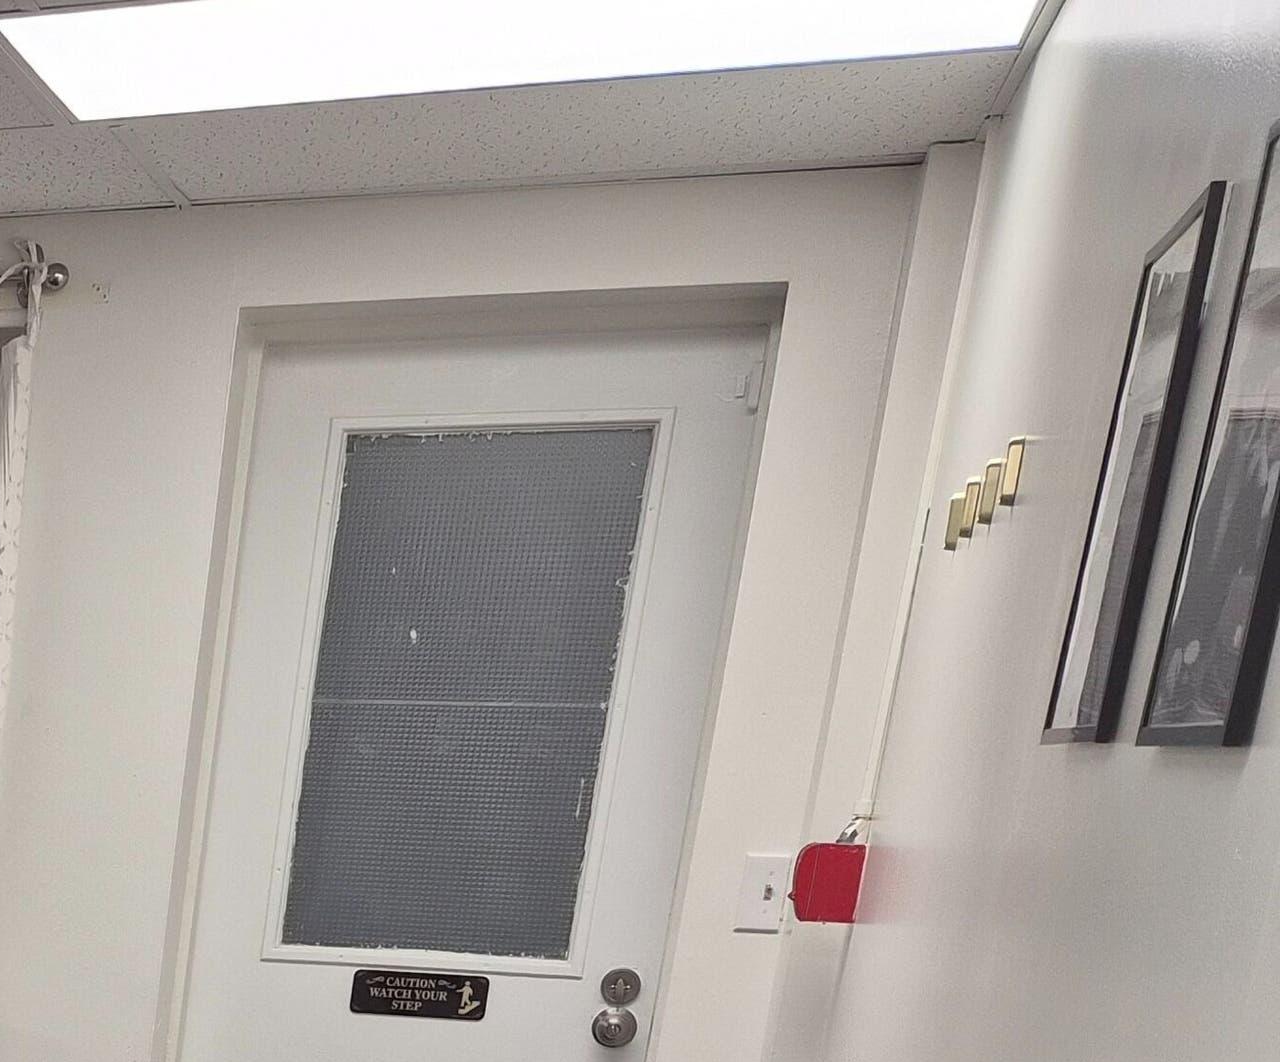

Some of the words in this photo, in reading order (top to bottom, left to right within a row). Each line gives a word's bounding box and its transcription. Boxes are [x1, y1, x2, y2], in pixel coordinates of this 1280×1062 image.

[386, 977, 437, 988] CAUTION
[370, 987, 413, 999] WATCH
[414, 990, 448, 1001] YOUR
[391, 1000, 423, 1011] STEP
